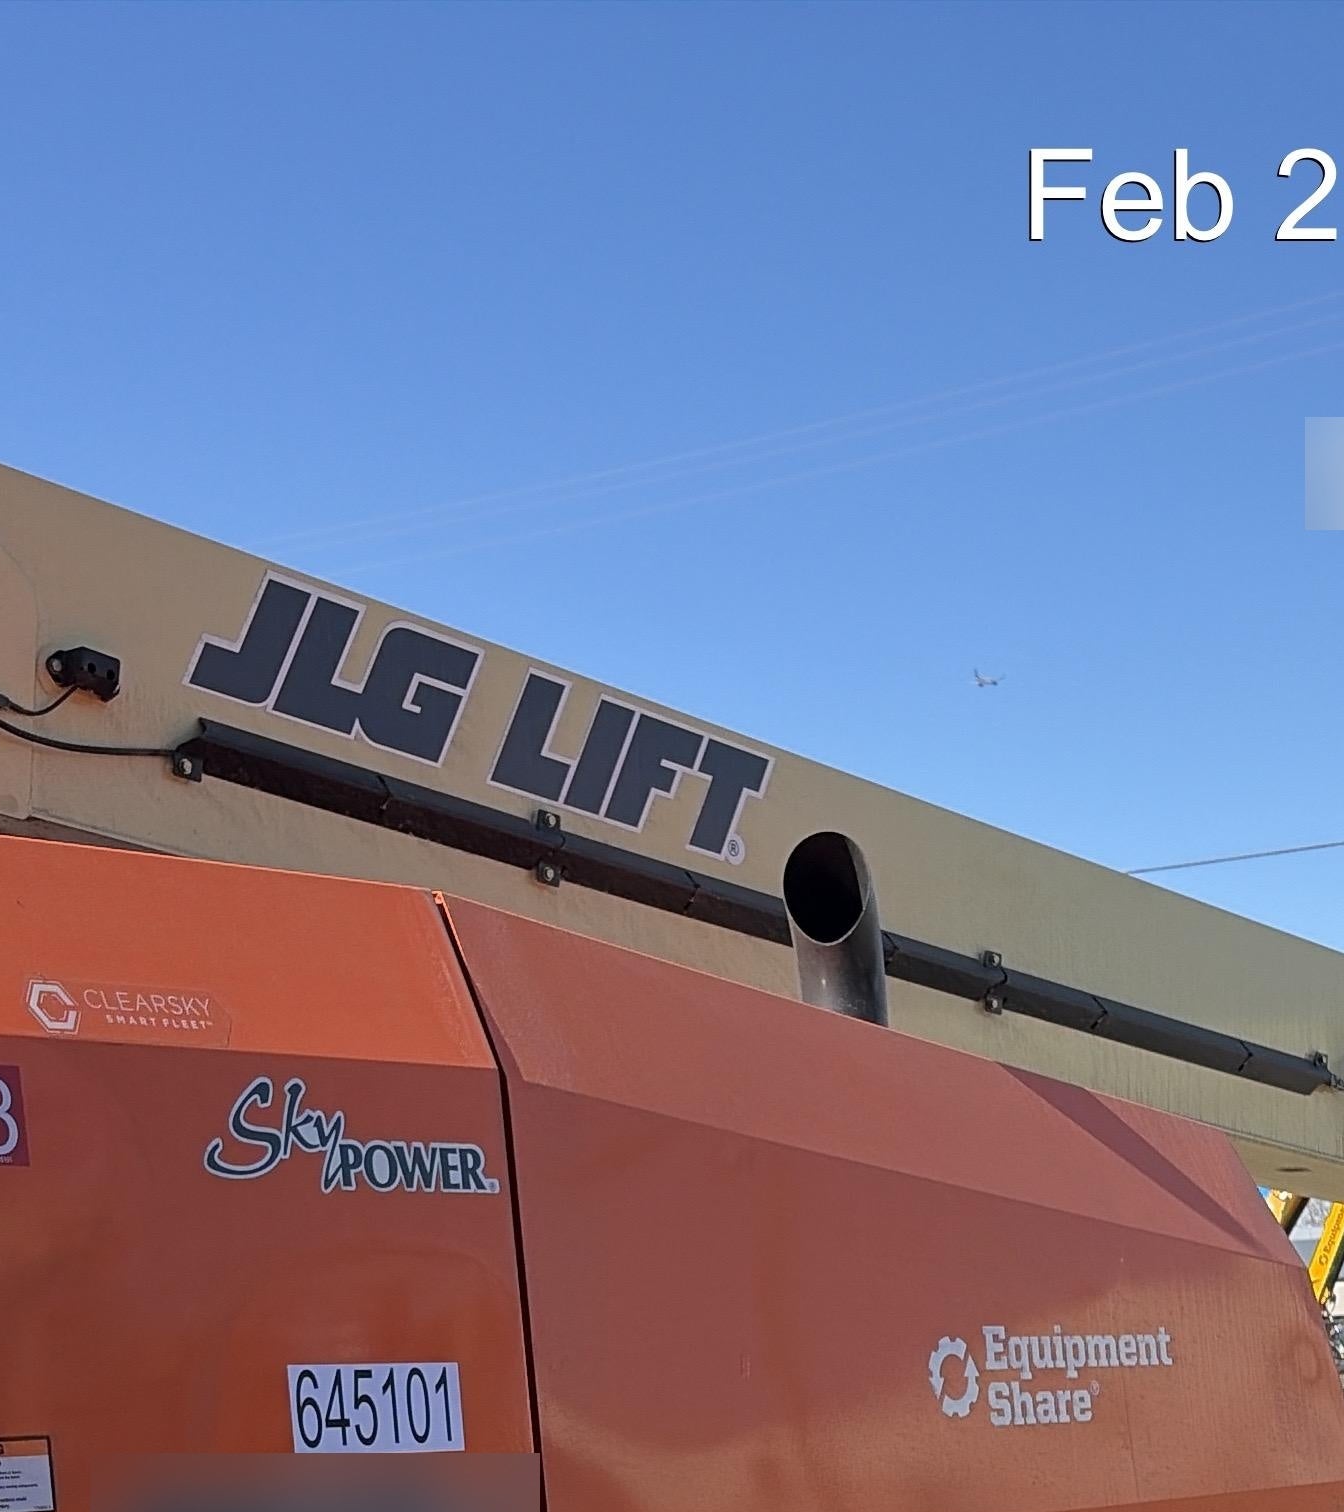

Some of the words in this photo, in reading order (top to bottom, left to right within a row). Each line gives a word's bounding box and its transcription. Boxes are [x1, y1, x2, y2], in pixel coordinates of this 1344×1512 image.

[183, 570, 485, 767] JLG
[487, 667, 775, 859] LIFT
[83, 988, 210, 1016] CLEARSKY
[105, 1014, 157, 1026] SMART
[982, 1325, 1173, 1380] Equipment
[296, 1366, 453, 1449] 645101
[987, 1381, 1093, 1426] Share
